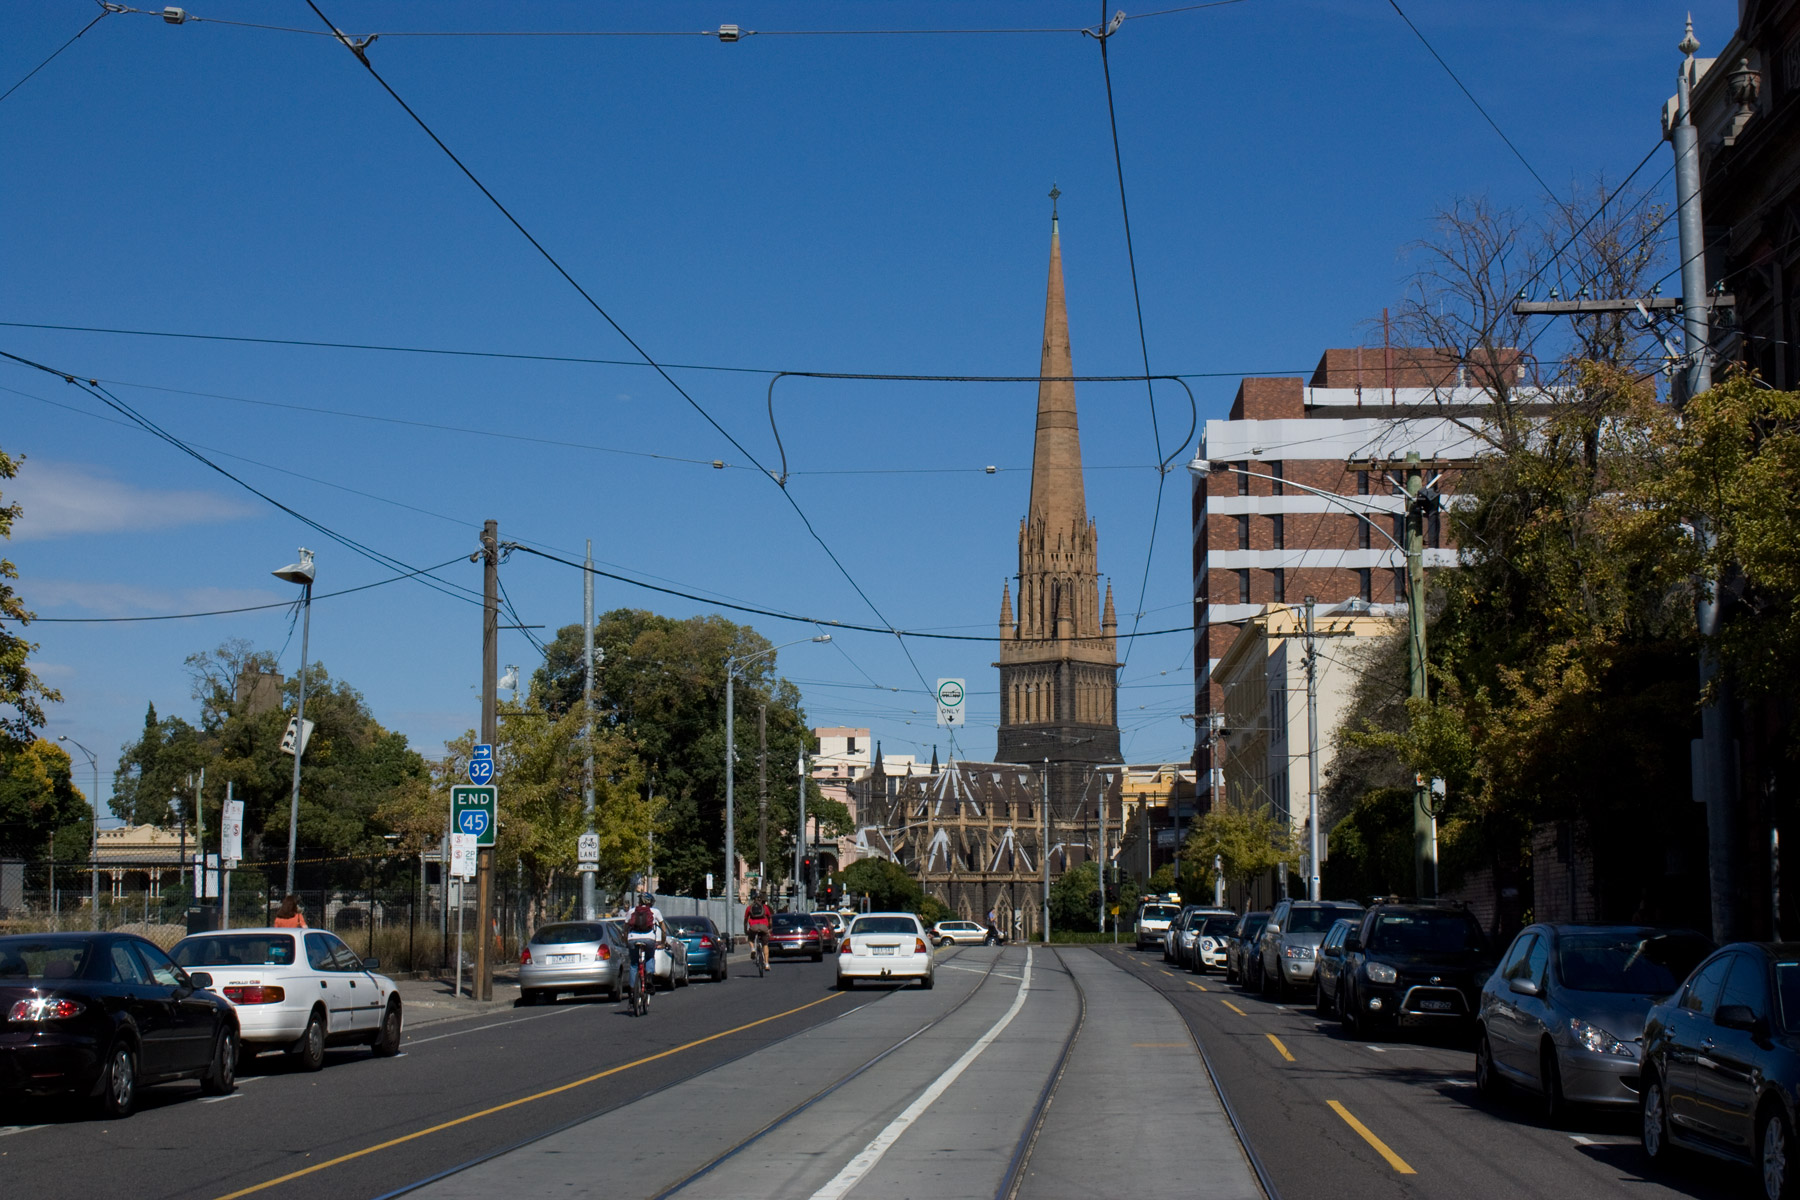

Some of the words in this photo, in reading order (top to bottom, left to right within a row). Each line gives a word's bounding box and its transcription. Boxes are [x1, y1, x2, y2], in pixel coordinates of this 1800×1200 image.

[471, 762, 490, 777] 32
[457, 793, 490, 805] END
[463, 814, 484, 831] 45
[465, 850, 475, 858] 2P
